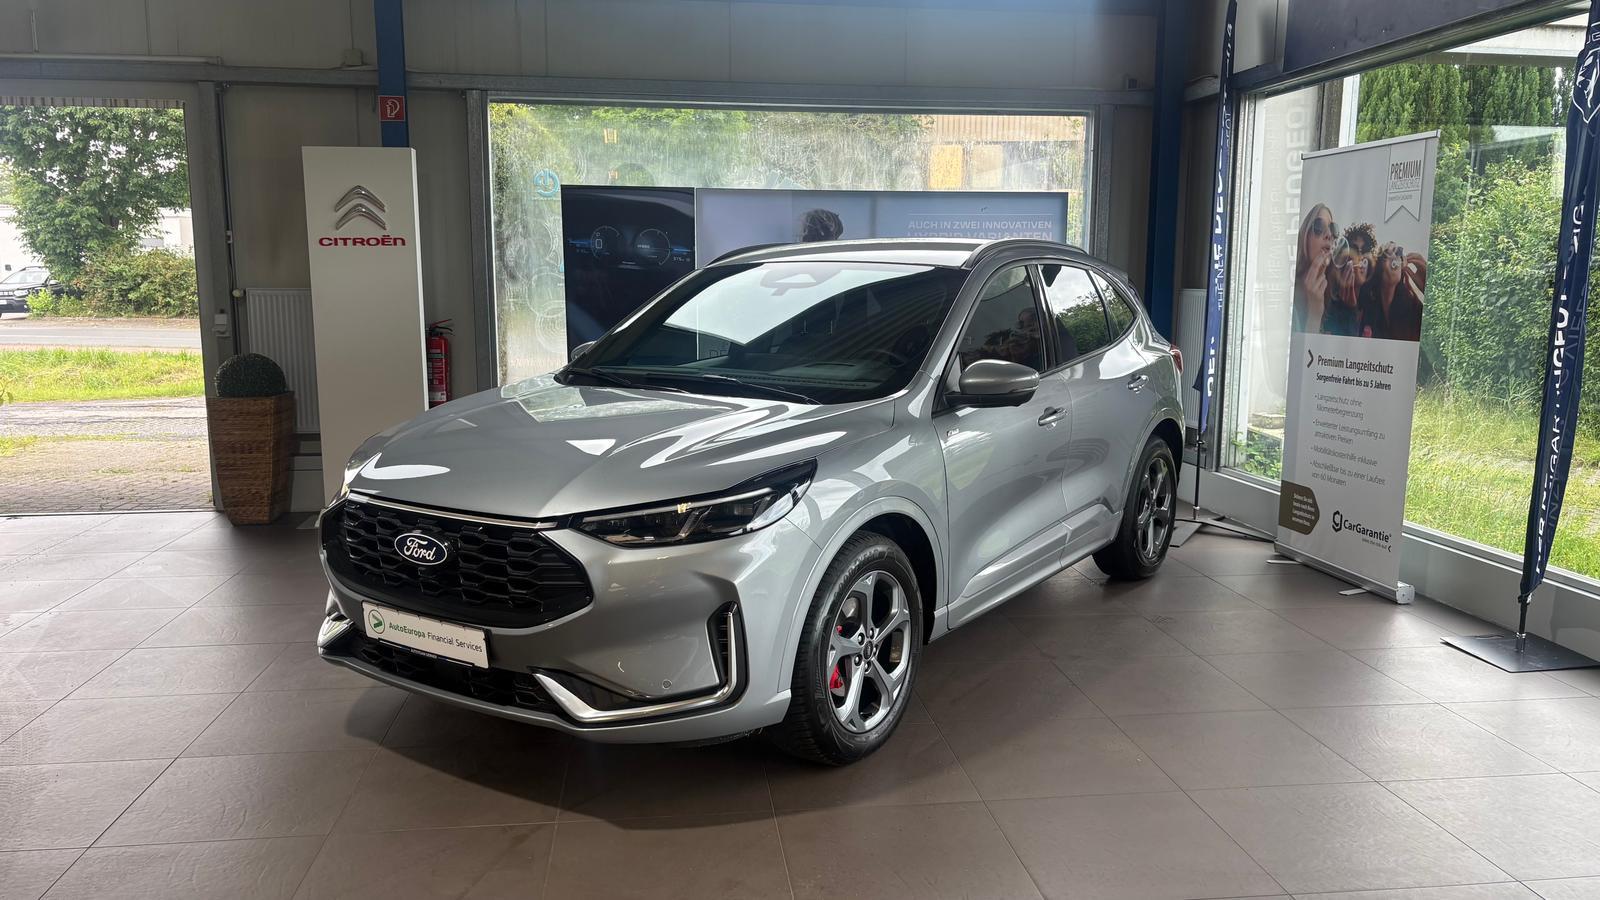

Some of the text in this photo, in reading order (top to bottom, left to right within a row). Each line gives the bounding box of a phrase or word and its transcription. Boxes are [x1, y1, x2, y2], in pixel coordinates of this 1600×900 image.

[1390, 160, 1421, 181] PREMIUM
[908, 221, 1052, 229] AUCH IN ZWEI INNOVATIVEN
[318, 234, 406, 247] CITROËN
[1317, 355, 1394, 374] Premium Langzeitschutz
[1316, 372, 1342, 384] Sorgenfreie
[1342, 376, 1355, 386] Fahrt
[1355, 378, 1363, 387] bis
[1374, 381, 1392, 391] Jahren
[1343, 520, 1390, 542] CarGarantie
[403, 537, 436, 561] Ford
[389, 622, 483, 653] AutoEuropa Financial Services
